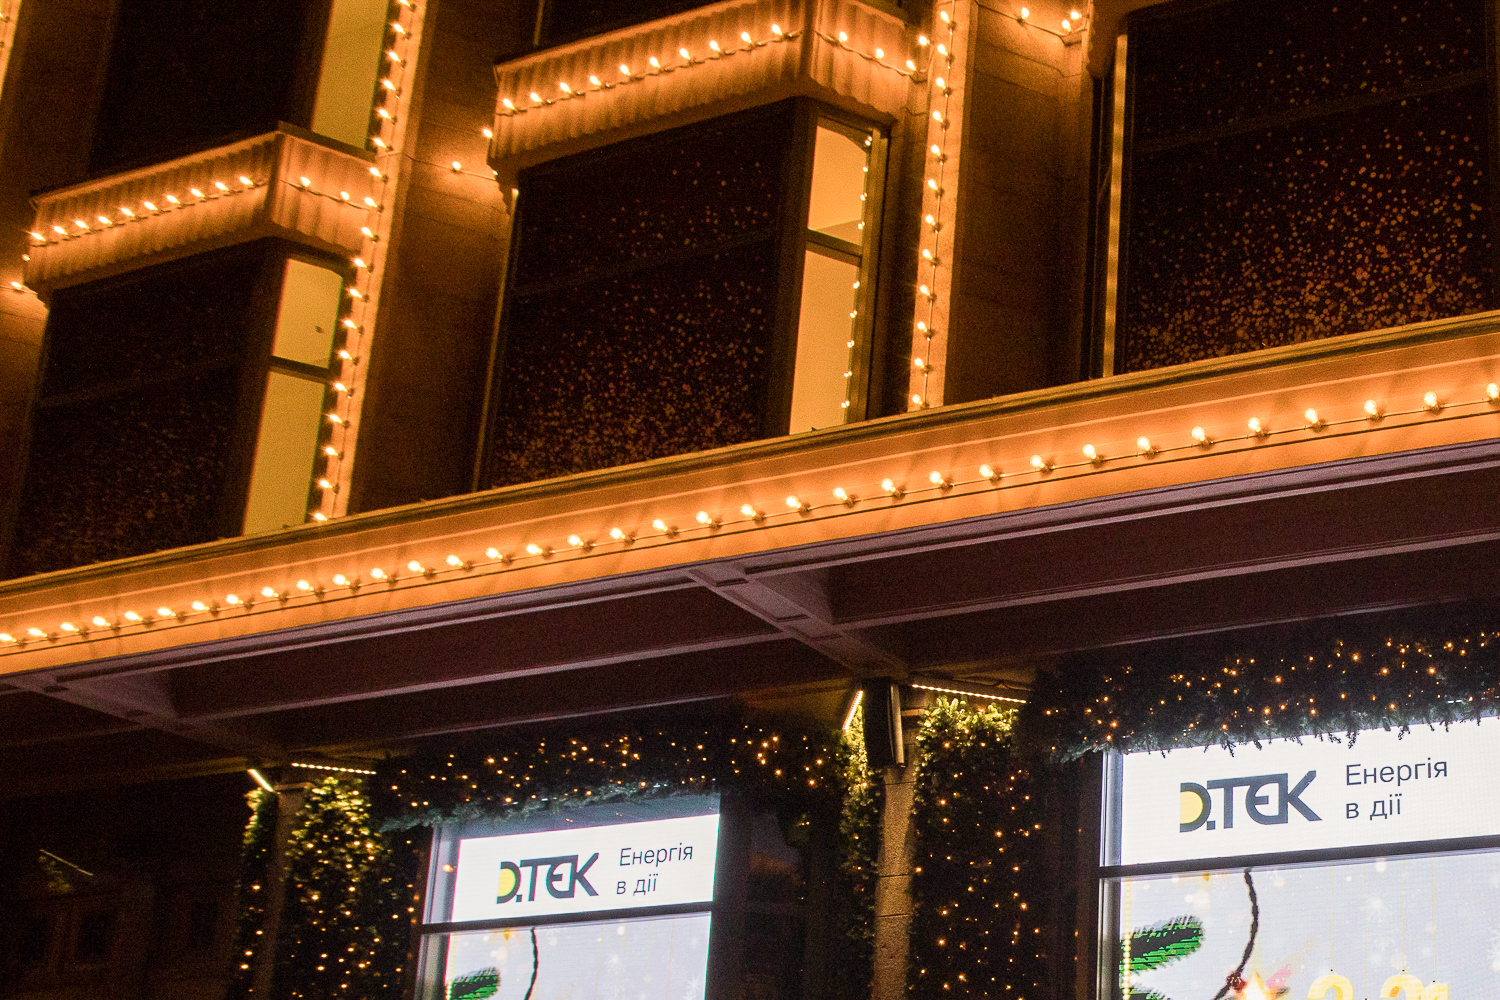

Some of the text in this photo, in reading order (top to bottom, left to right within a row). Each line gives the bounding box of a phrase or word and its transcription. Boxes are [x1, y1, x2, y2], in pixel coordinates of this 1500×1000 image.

[1345, 757, 1448, 787] Енергія
[1345, 793, 1403, 821] в дії
[619, 842, 693, 868] Енергія
[616, 873, 659, 896] в дії
